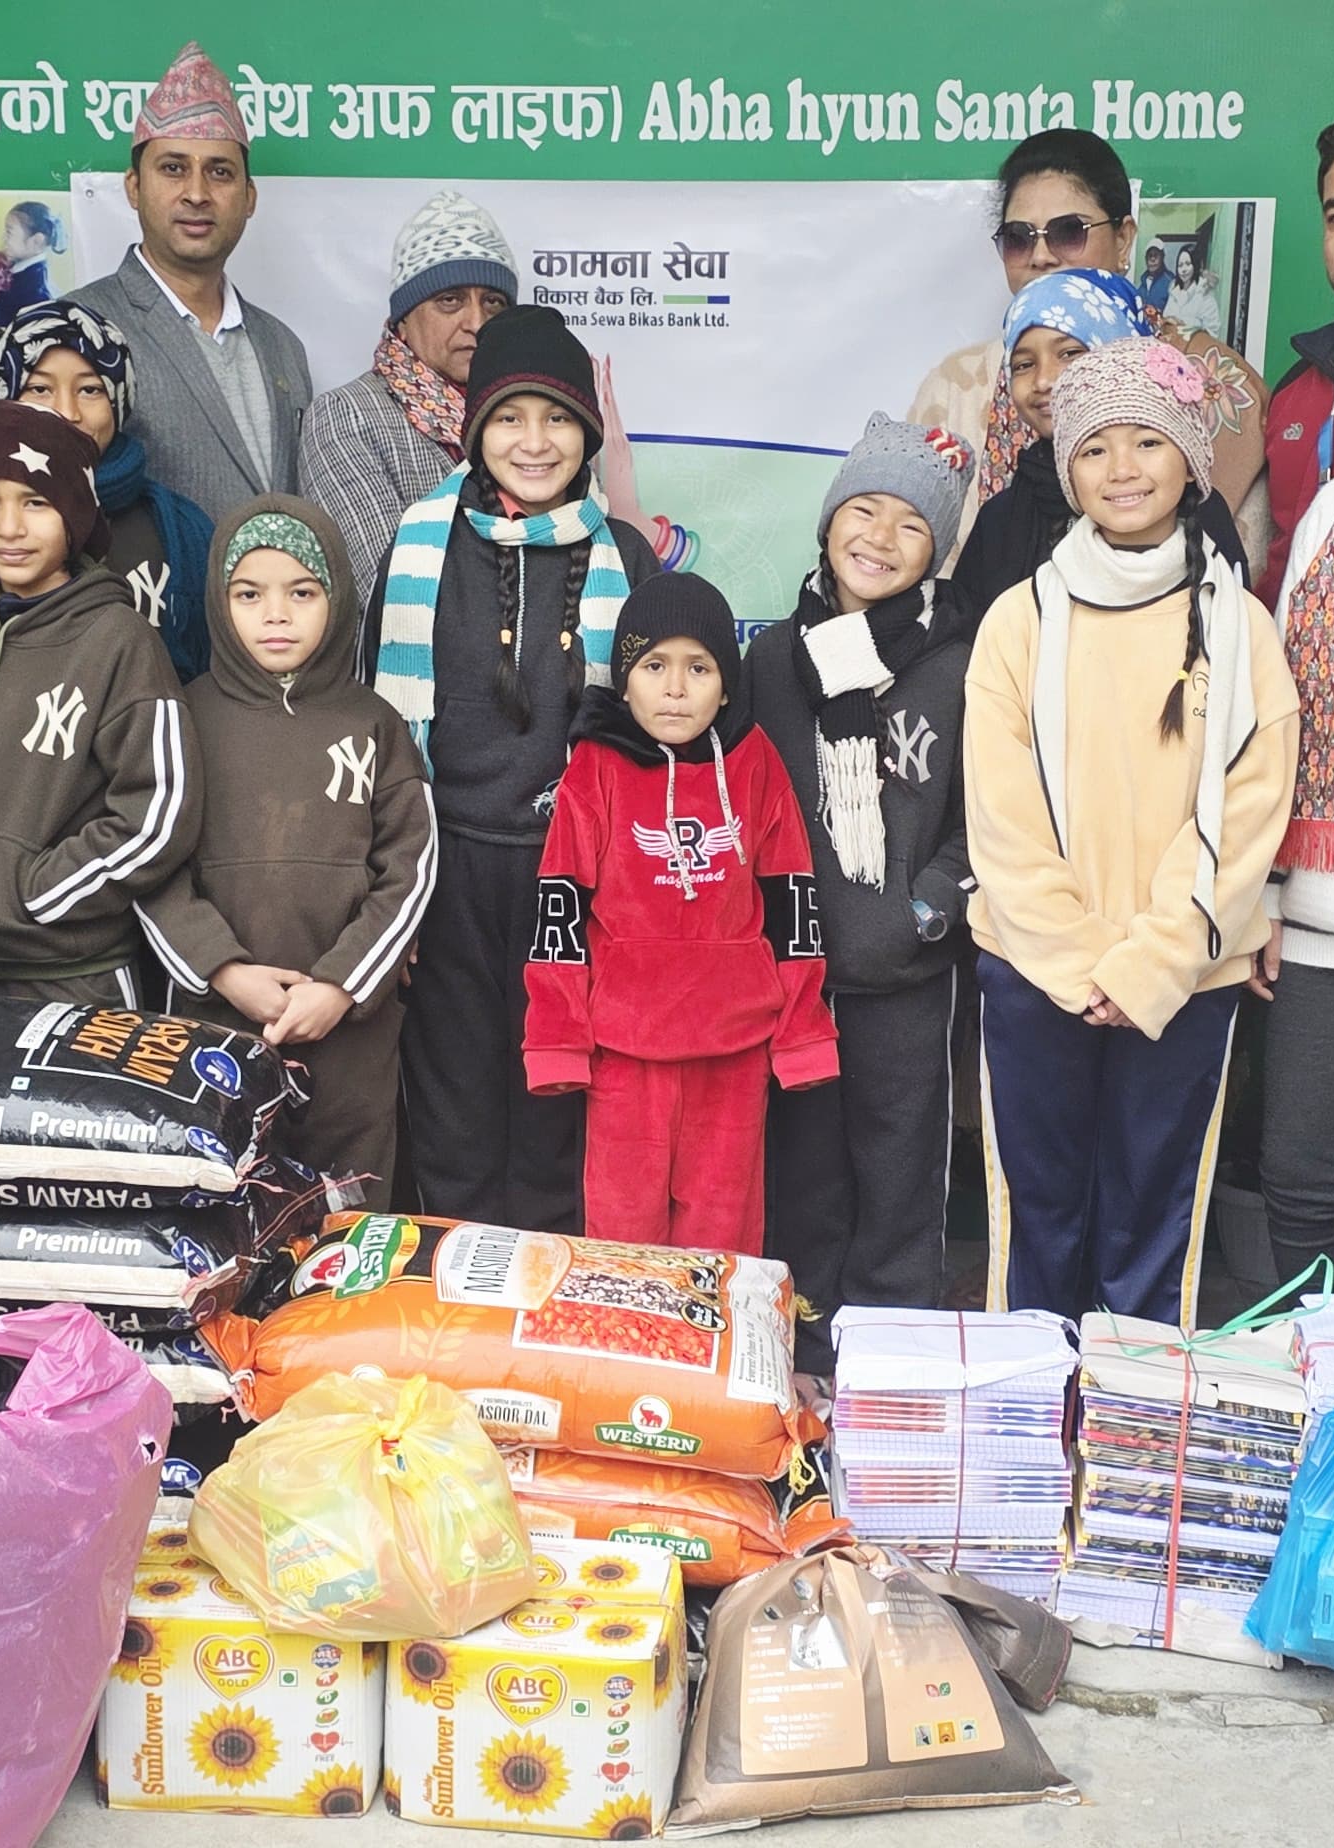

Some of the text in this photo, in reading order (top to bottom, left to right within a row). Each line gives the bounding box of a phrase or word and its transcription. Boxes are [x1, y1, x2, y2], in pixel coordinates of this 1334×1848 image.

[328, 84, 435, 140] अफ
[451, 85, 623, 151] लाइफ)
[639, 78, 1245, 156] Abha hyun Santa Home
[533, 241, 730, 281] कामना सेवा
[533, 286, 588, 306] विकास
[591, 312, 625, 327] Sewa
[629, 312, 664, 327] Bikas
[668, 313, 701, 328] Bank
[705, 313, 730, 328] Ltd.
[21, 682, 88, 761] NY
[324, 735, 376, 805] NY
[528, 879, 585, 965] R
[70, 1008, 144, 1060] SUKH
[121, 1014, 202, 1086] PARAM
[30, 1111, 158, 1143] Premium
[28, 1184, 152, 1209] PARAM
[17, 1227, 143, 1256] Premium
[463, 1243, 515, 1294] MASOOR
[524, 1410, 549, 1427] DAL
[600, 1427, 696, 1453] WESTERN
[215, 1649, 261, 1668] ABC
[218, 1678, 249, 1688] GOLD
[506, 1677, 553, 1697] ABC
[139, 1656, 164, 1794] Sunflower Oil
[509, 1705, 541, 1715] GOLD
[431, 1680, 455, 1818] Sunflower Oil
